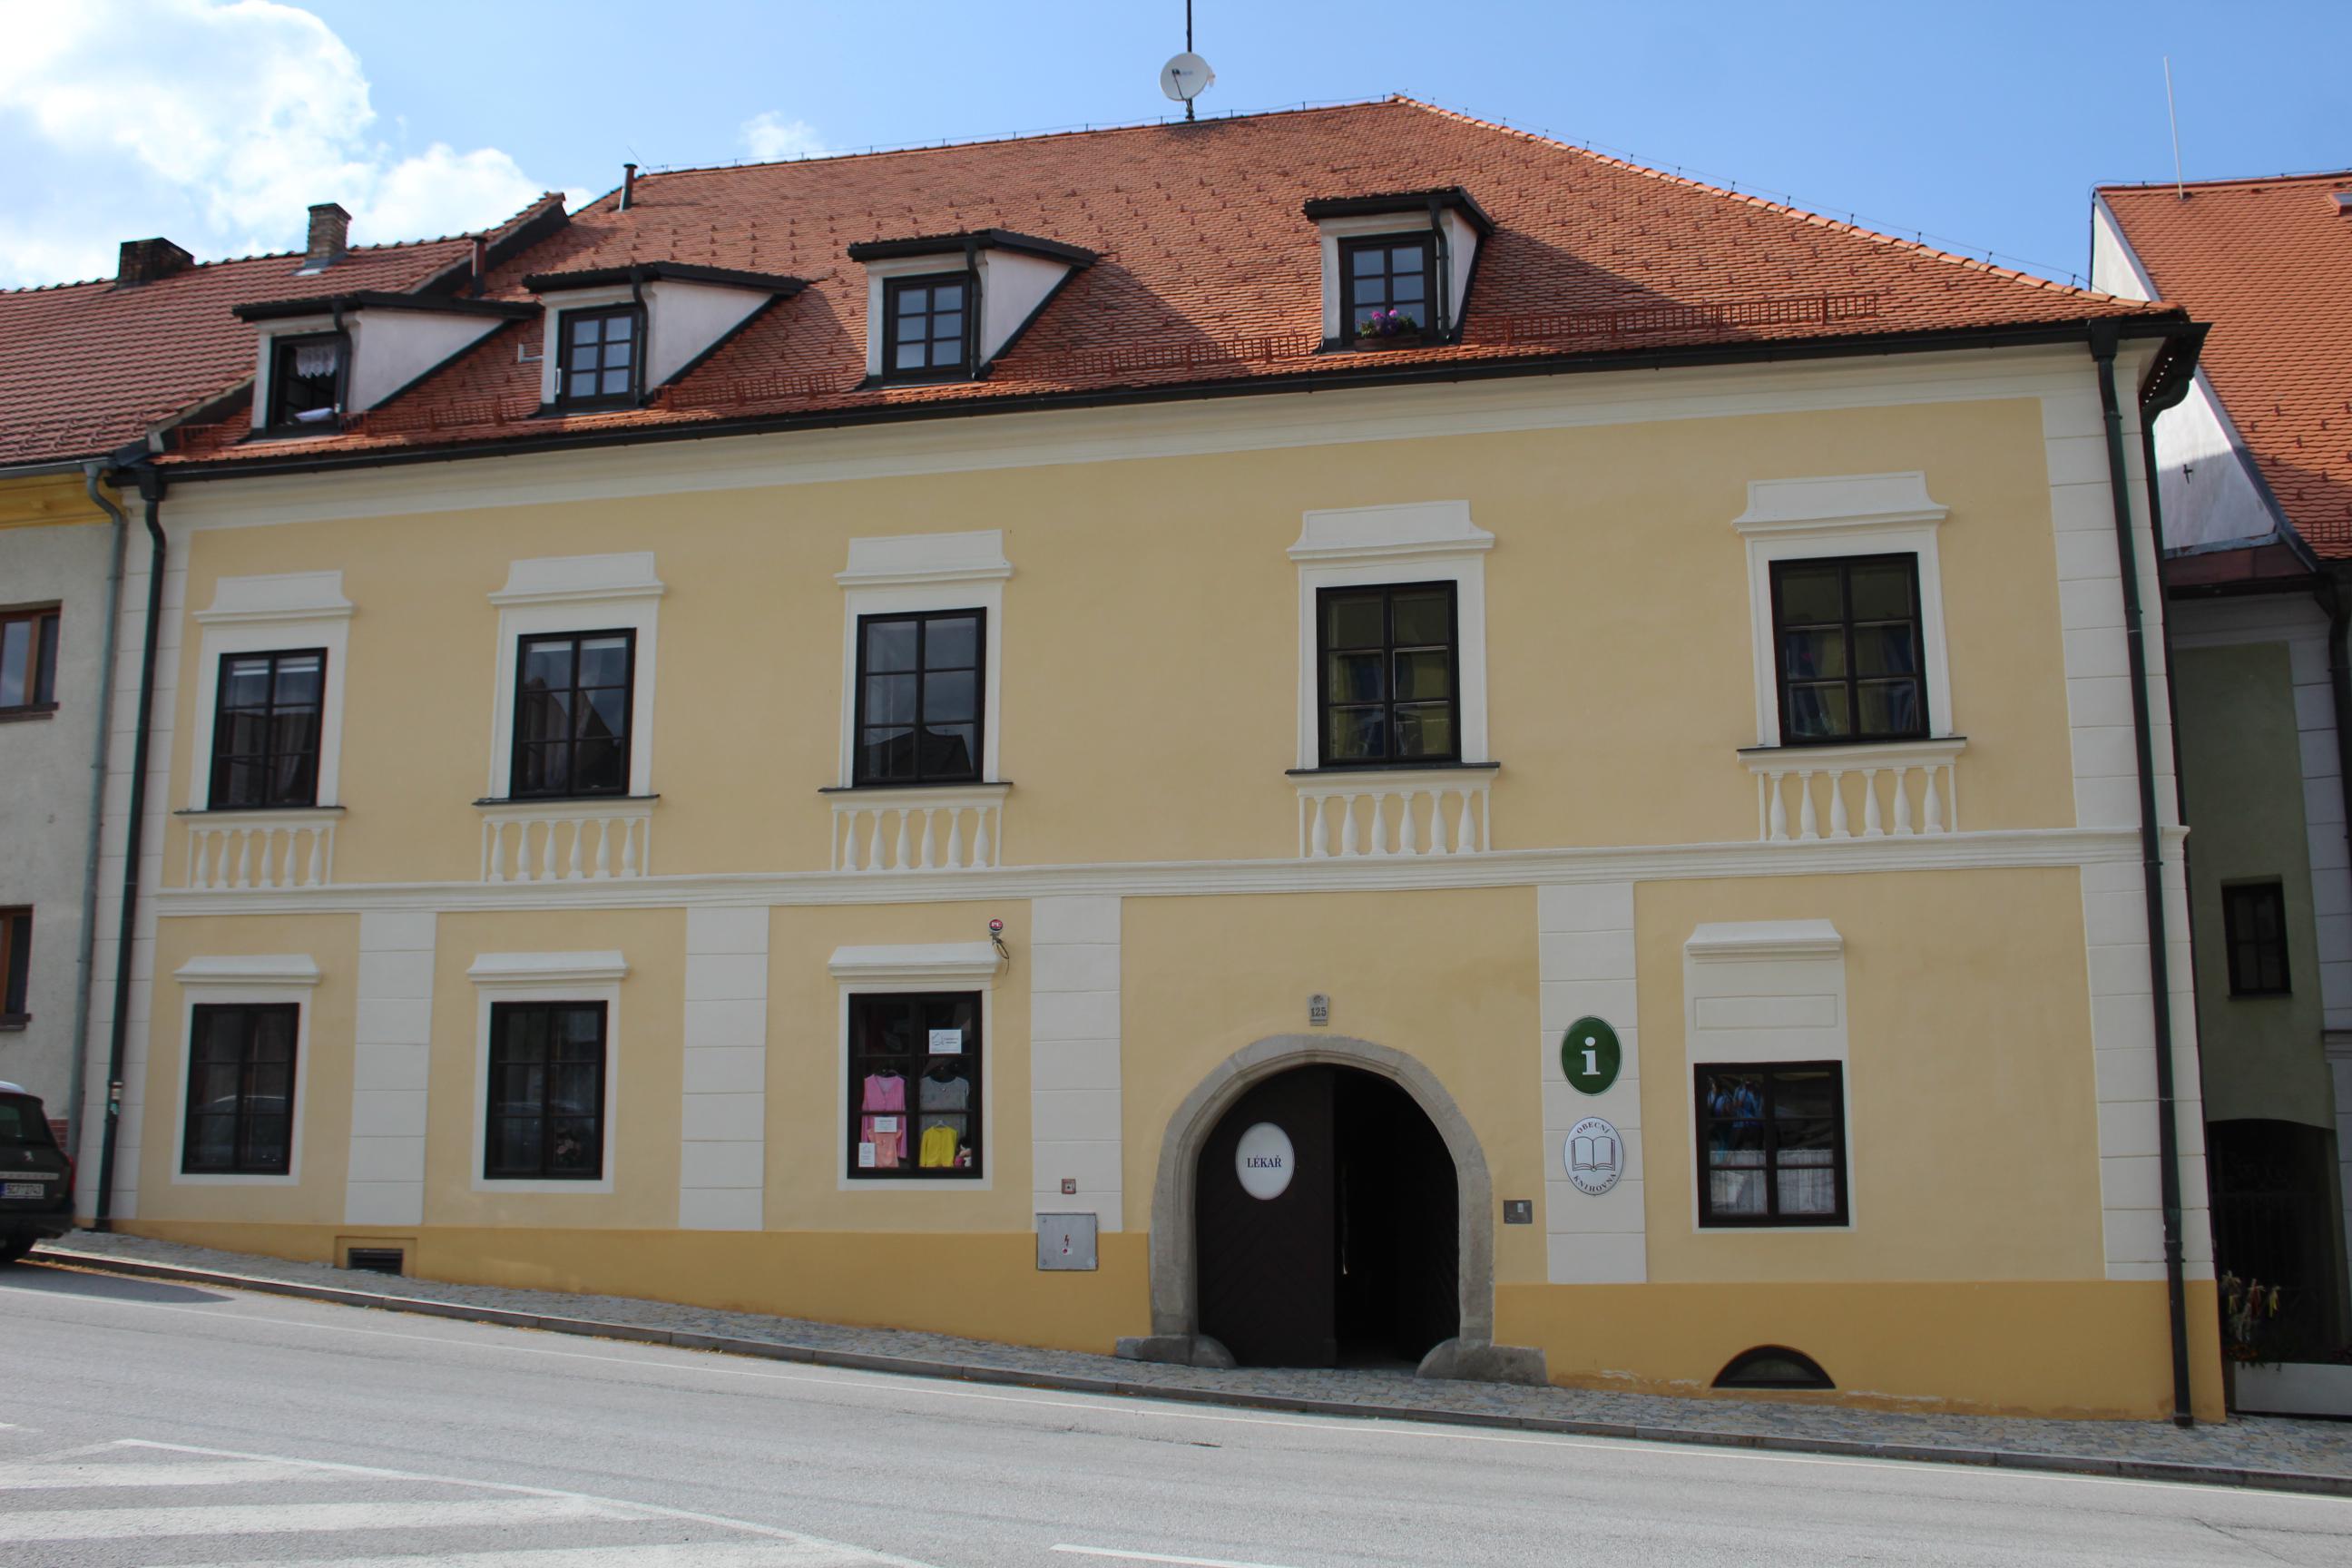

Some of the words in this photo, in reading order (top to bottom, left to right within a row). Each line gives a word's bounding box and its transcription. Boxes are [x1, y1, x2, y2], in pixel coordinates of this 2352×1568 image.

[1311, 1007, 1327, 1017] 125
[1581, 1036, 1602, 1076] i
[1576, 1122, 1611, 1134] OBECNÍ
[1247, 1155, 1282, 1168] LÉKAŘ
[1573, 1173, 1617, 1192] KNIHOVNA
